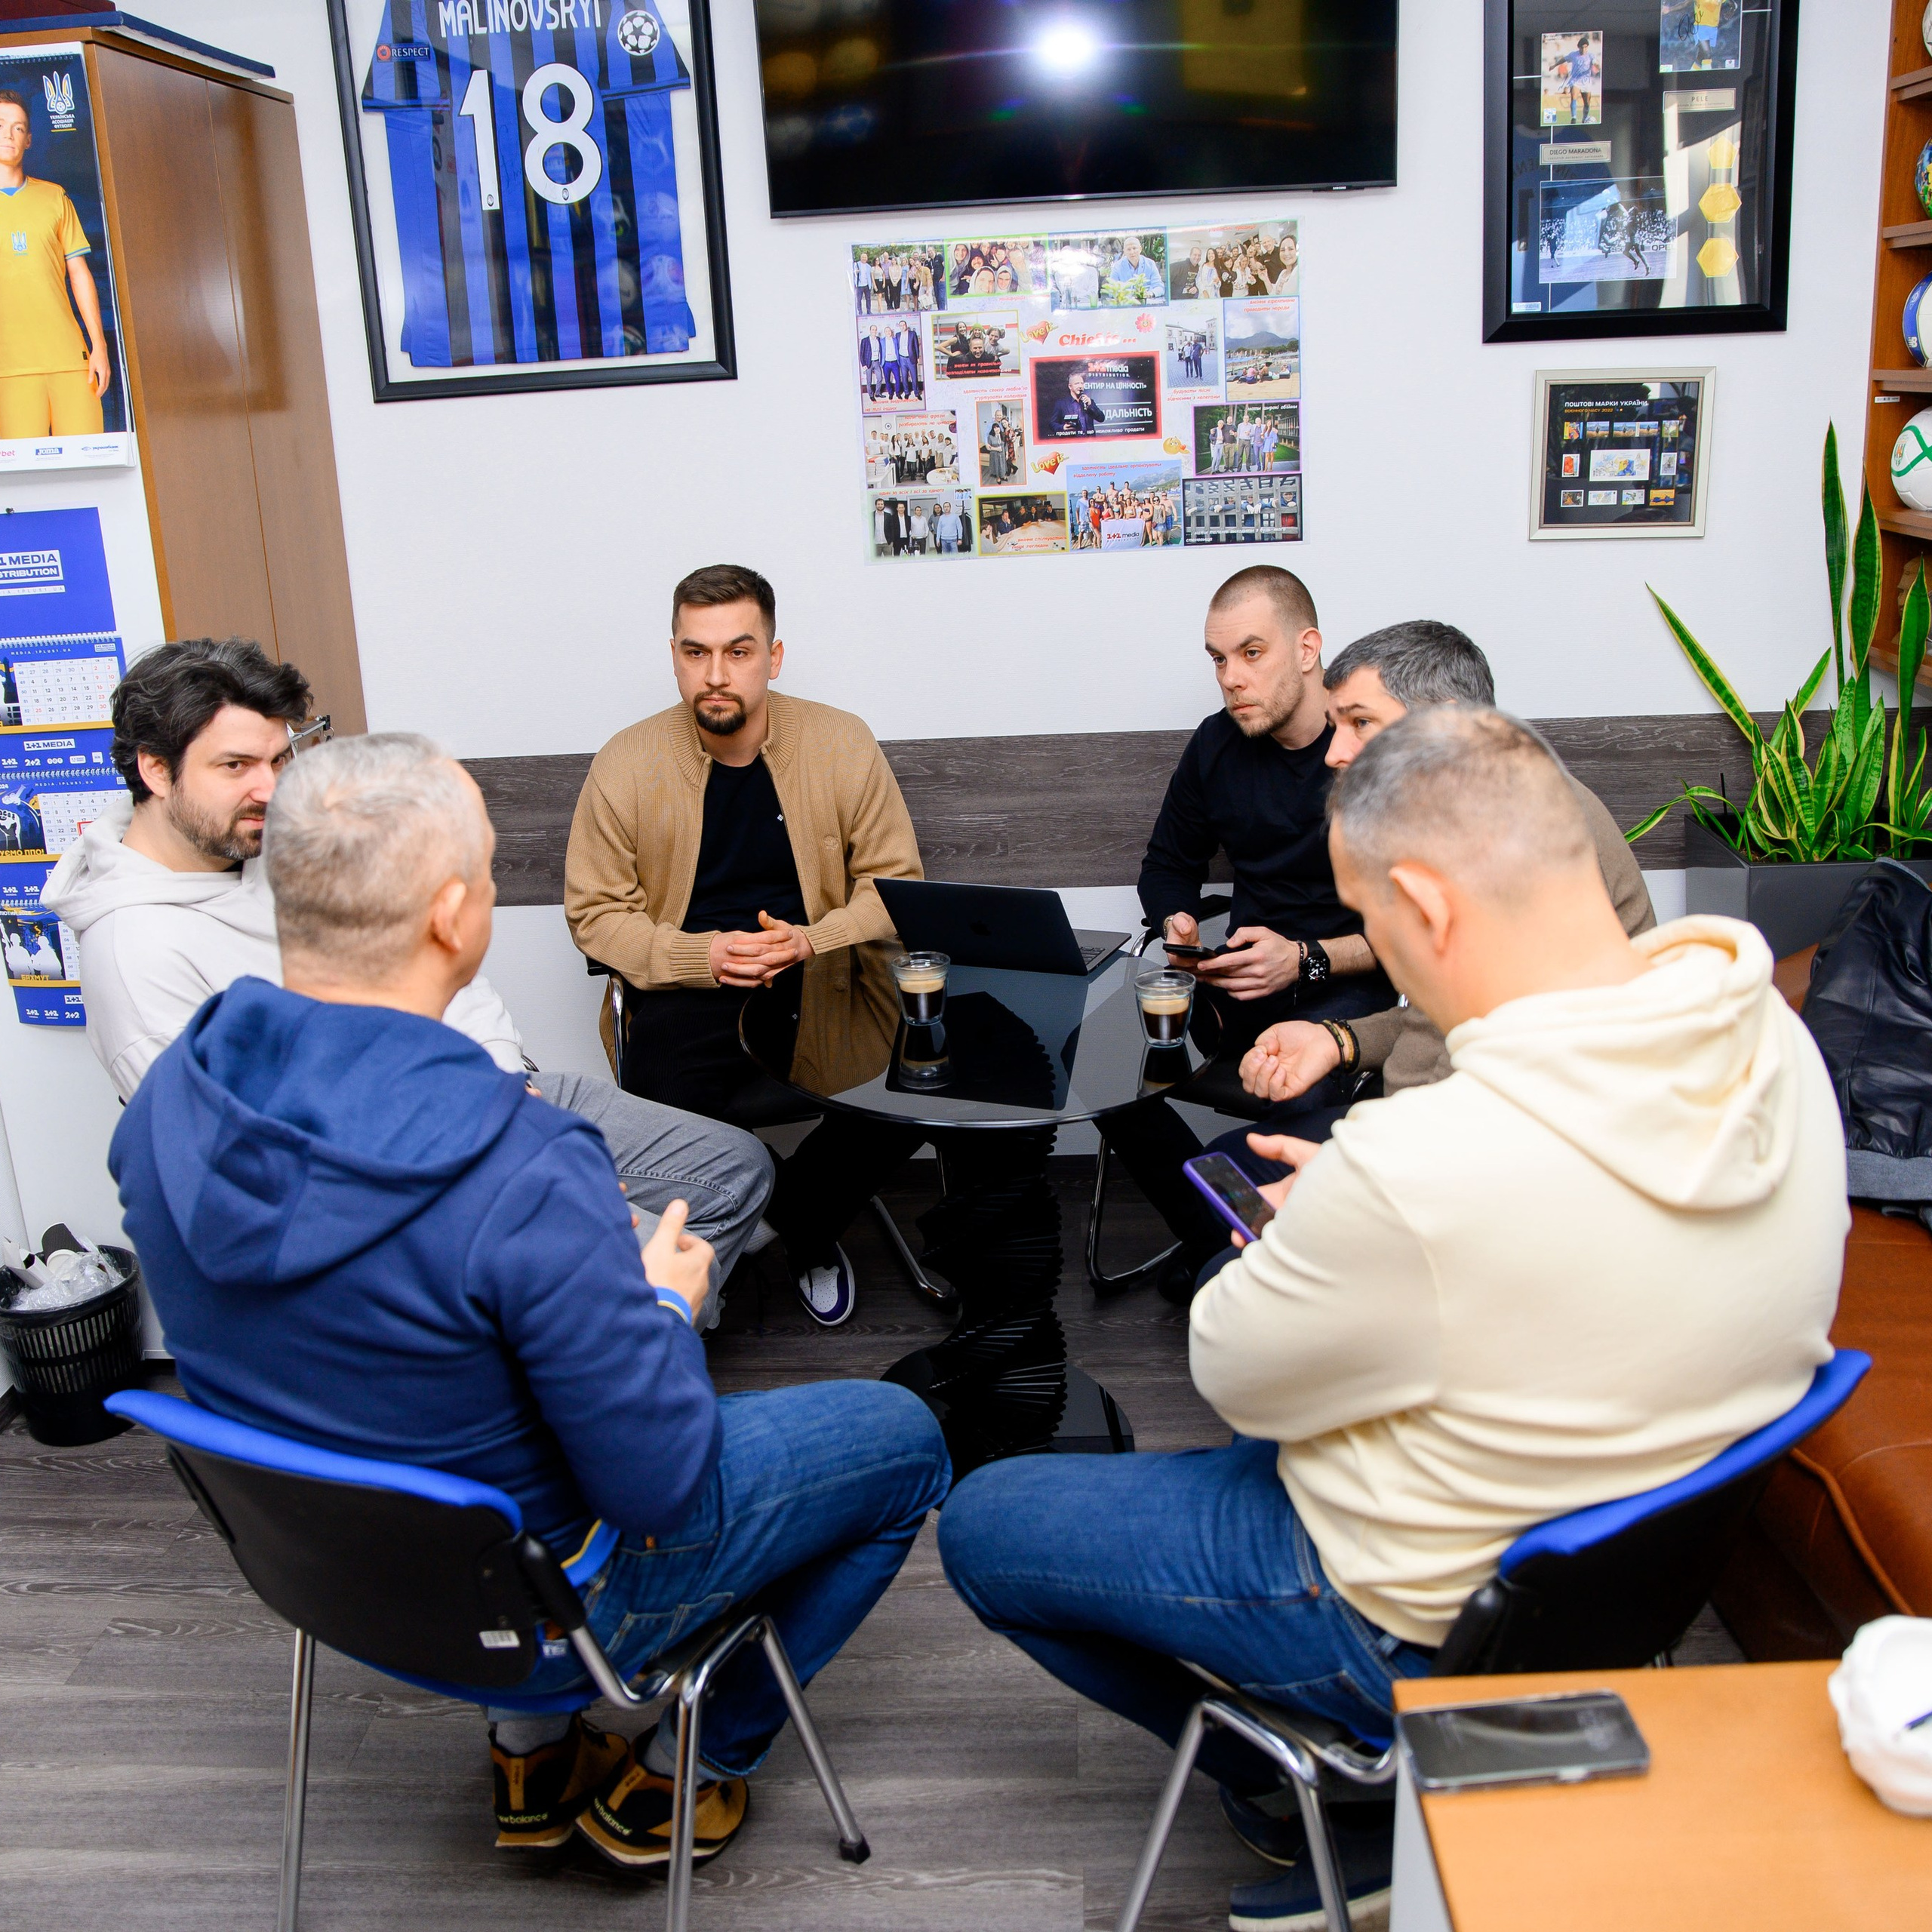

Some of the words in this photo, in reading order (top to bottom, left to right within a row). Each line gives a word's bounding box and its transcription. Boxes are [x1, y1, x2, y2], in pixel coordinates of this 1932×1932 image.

[391, 47, 429, 57] RESPECT
[460, 63, 601, 211] 18
[1020, 326, 1044, 343] Love
[1106, 364, 1129, 373] media
[1031, 457, 1056, 473] Love
[8, 554, 57, 565] MEDIA
[24, 758, 41, 767] 2+2
